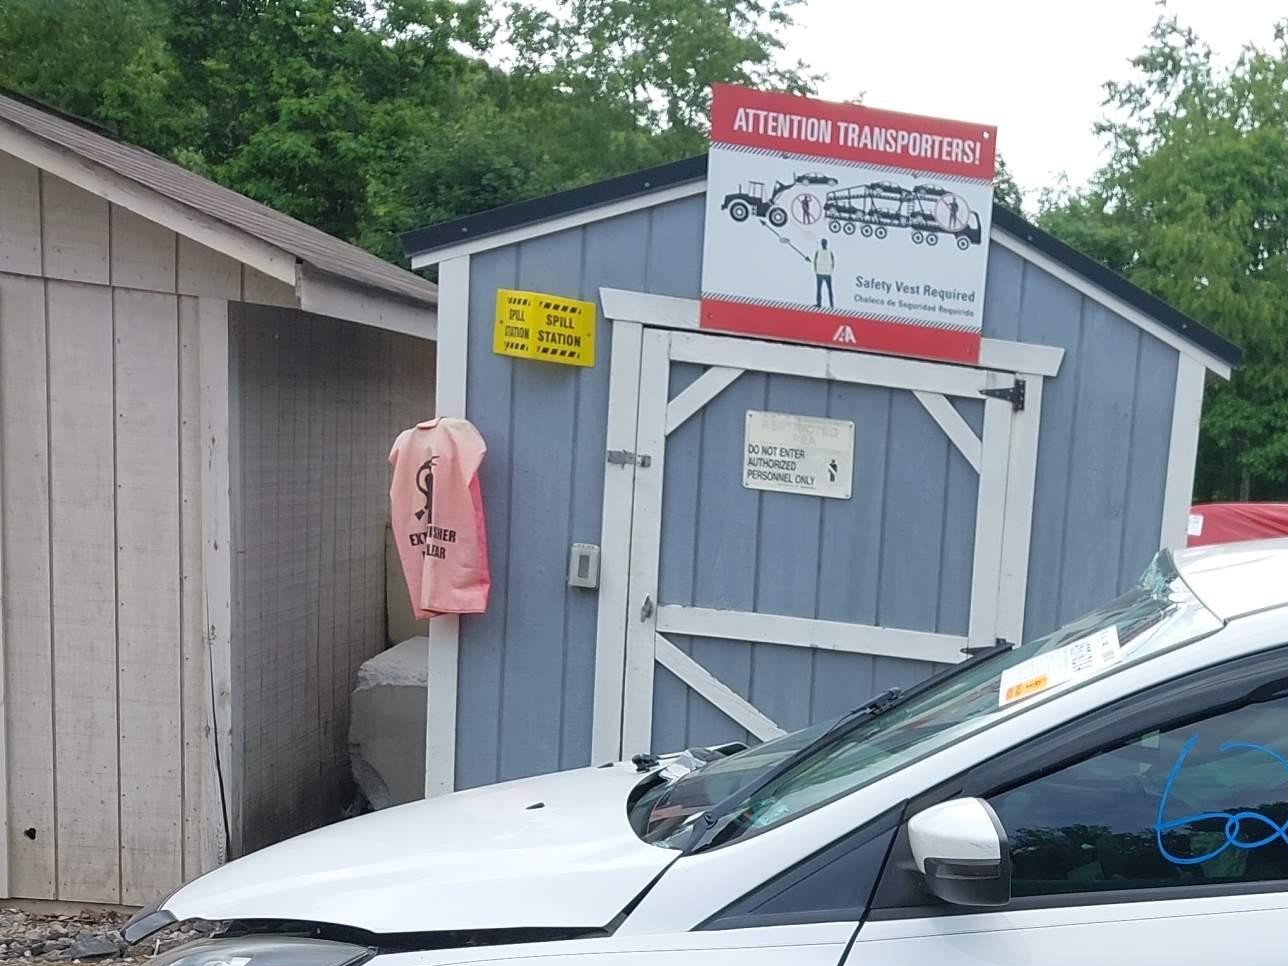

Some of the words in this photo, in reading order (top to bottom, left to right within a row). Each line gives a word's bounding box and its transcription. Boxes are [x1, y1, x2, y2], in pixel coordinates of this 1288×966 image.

[733, 107, 832, 144] ATTENTION
[837, 121, 982, 165] TRANSPORTERS!
[855, 275, 892, 294] Safety
[895, 281, 920, 295] Vest
[923, 284, 976, 302] Required
[887, 299, 896, 307] de
[509, 308, 525, 322] SPILL
[546, 314, 575, 329] SPILL
[505, 325, 529, 339] STATION
[538, 330, 581, 347] STATION
[748, 444, 759, 454] DO
[761, 446, 777, 458] NOT
[780, 448, 805, 460] ENTER
[747, 458, 796, 471] AUTHORIZED
[747, 469, 792, 483] PERSONNEL
[795, 474, 816, 485] ONLY
